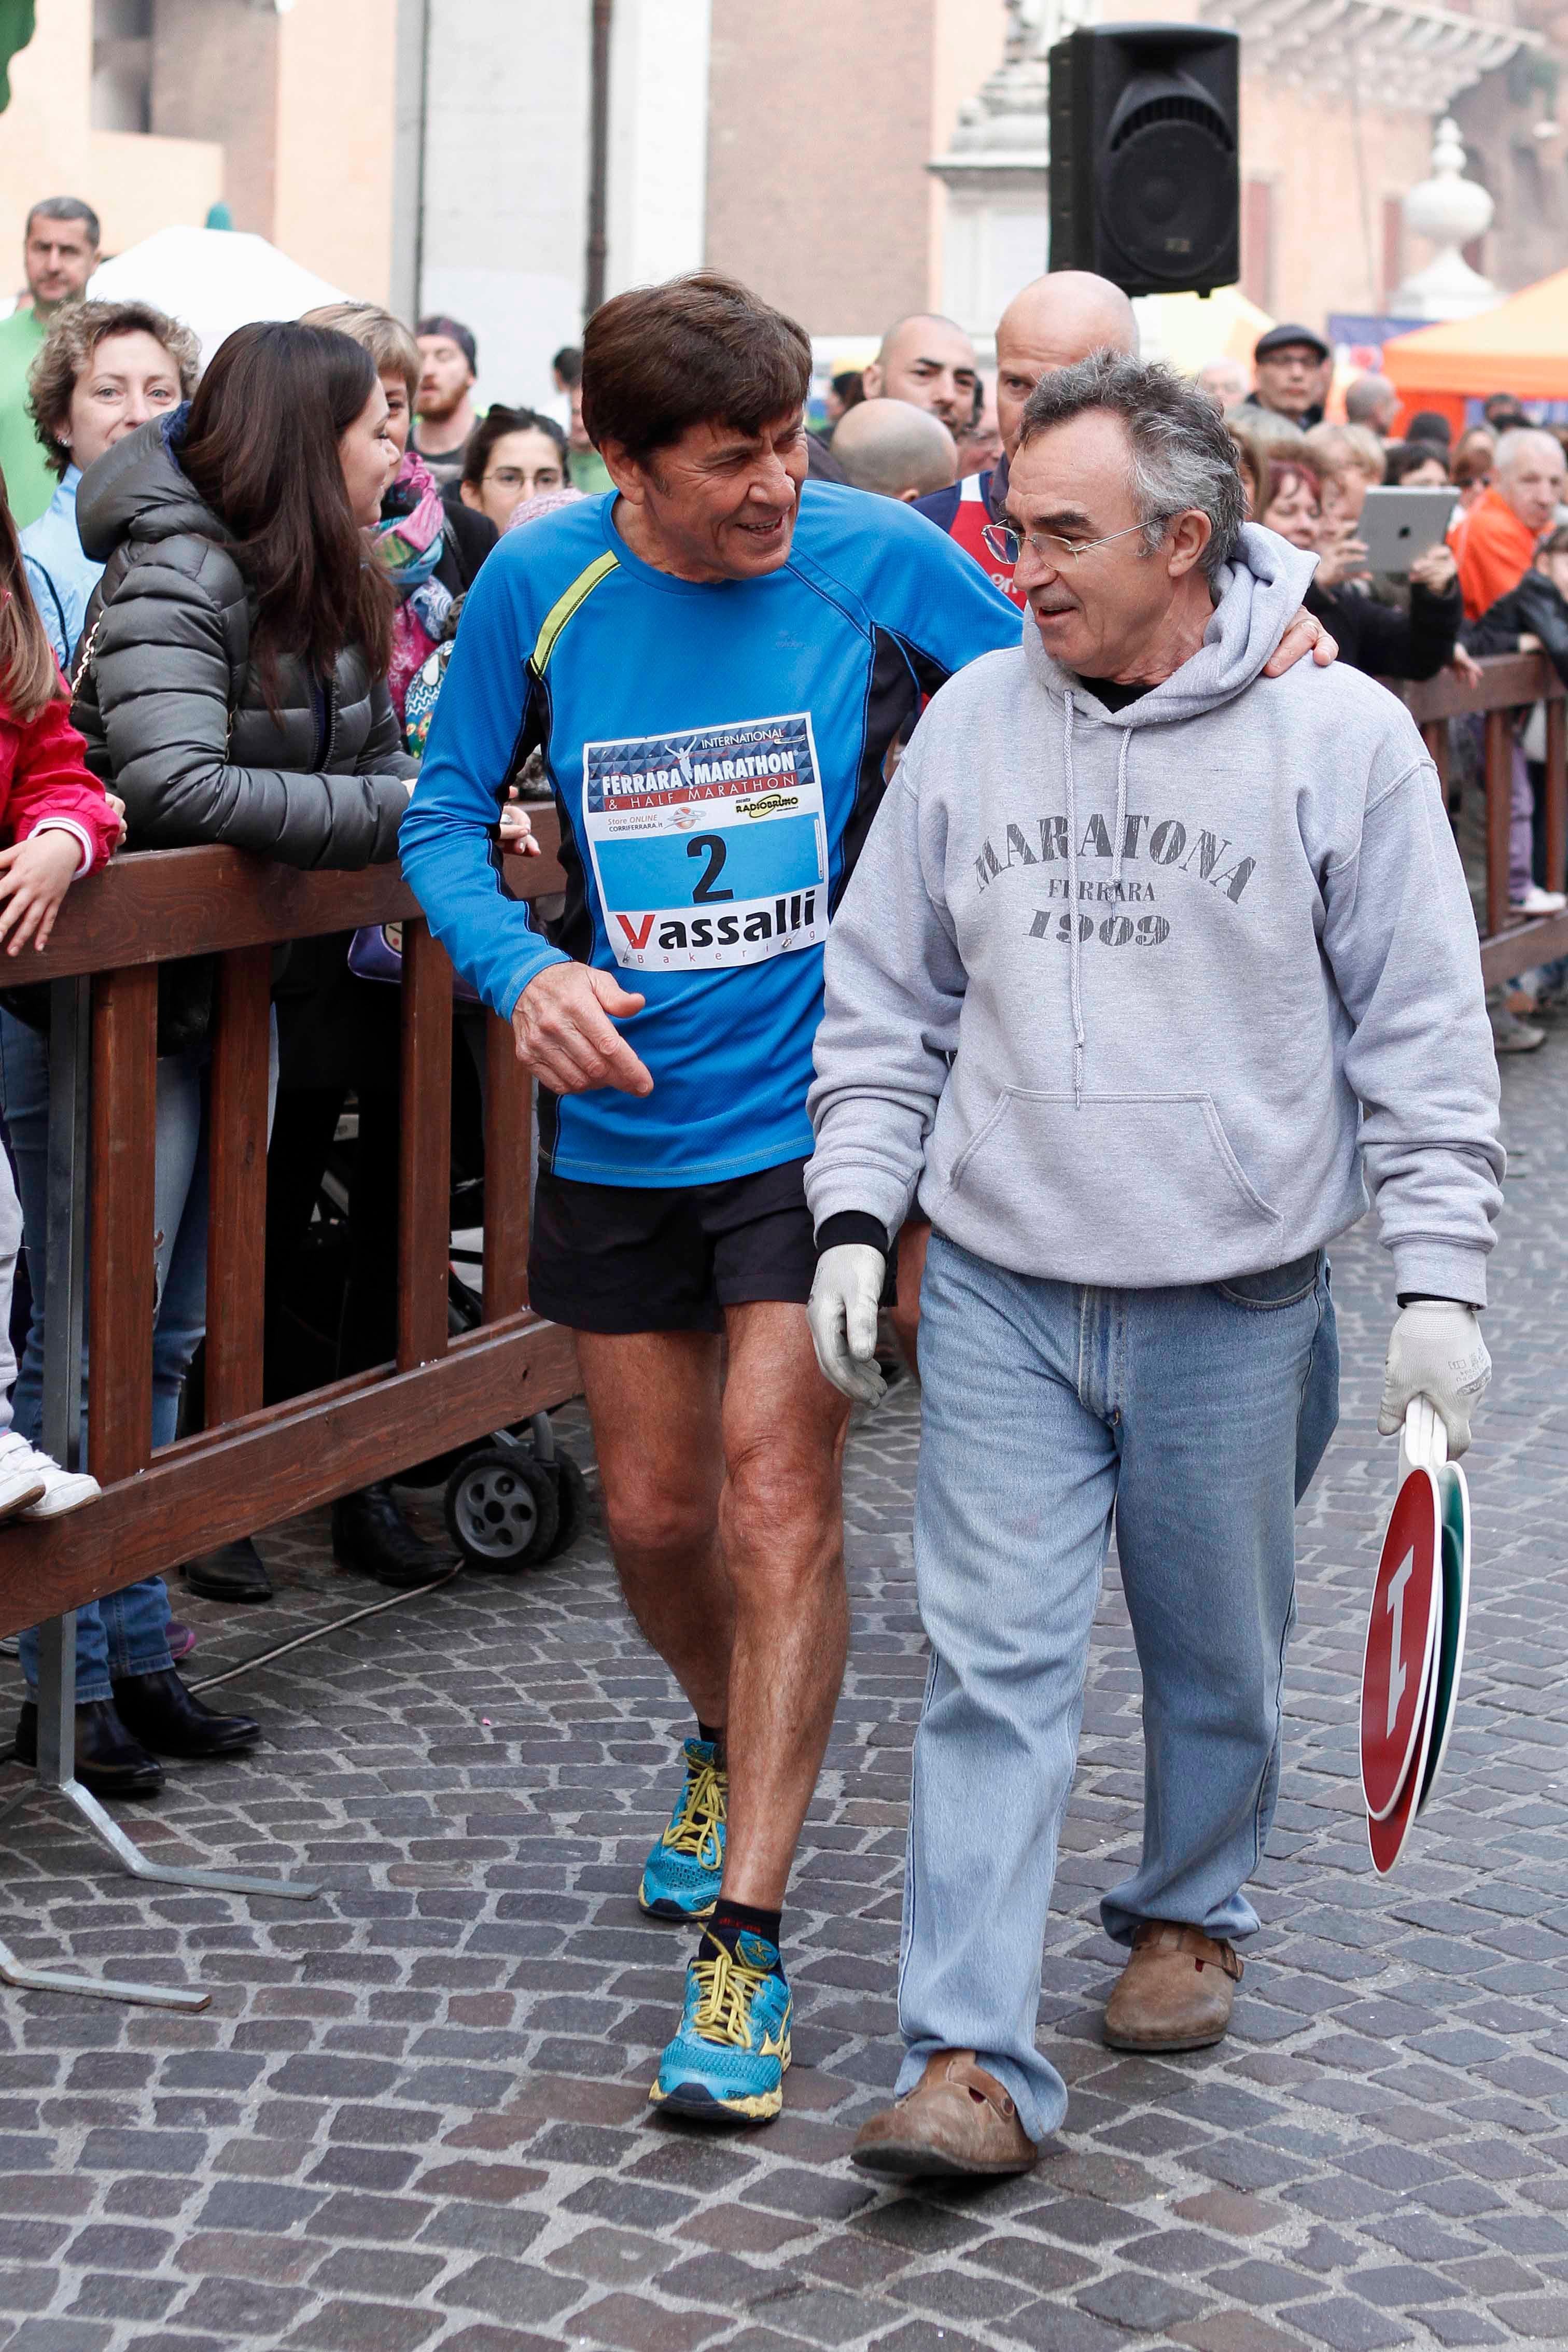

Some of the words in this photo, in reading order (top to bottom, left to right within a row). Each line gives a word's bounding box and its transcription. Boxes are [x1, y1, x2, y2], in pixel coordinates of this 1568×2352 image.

[701, 728, 784, 749] INTERNATIONAL
[602, 768, 683, 795] FERRARA
[694, 751, 795, 785] MARATHON
[609, 799, 618, 810] &
[631, 793, 674, 808] HALF
[688, 775, 795, 801] MARATHON
[736, 797, 799, 813] RADIOBRUNO
[609, 823, 664, 832] CORRIFERRARA.it
[629, 814, 658, 823] ONLINE
[687, 834, 734, 904] 2
[973, 814, 1257, 904] MARATONA
[615, 889, 816, 950] Vassalli
[1022, 908, 1170, 947] 1909
[637, 930, 815, 964] Bakerig
